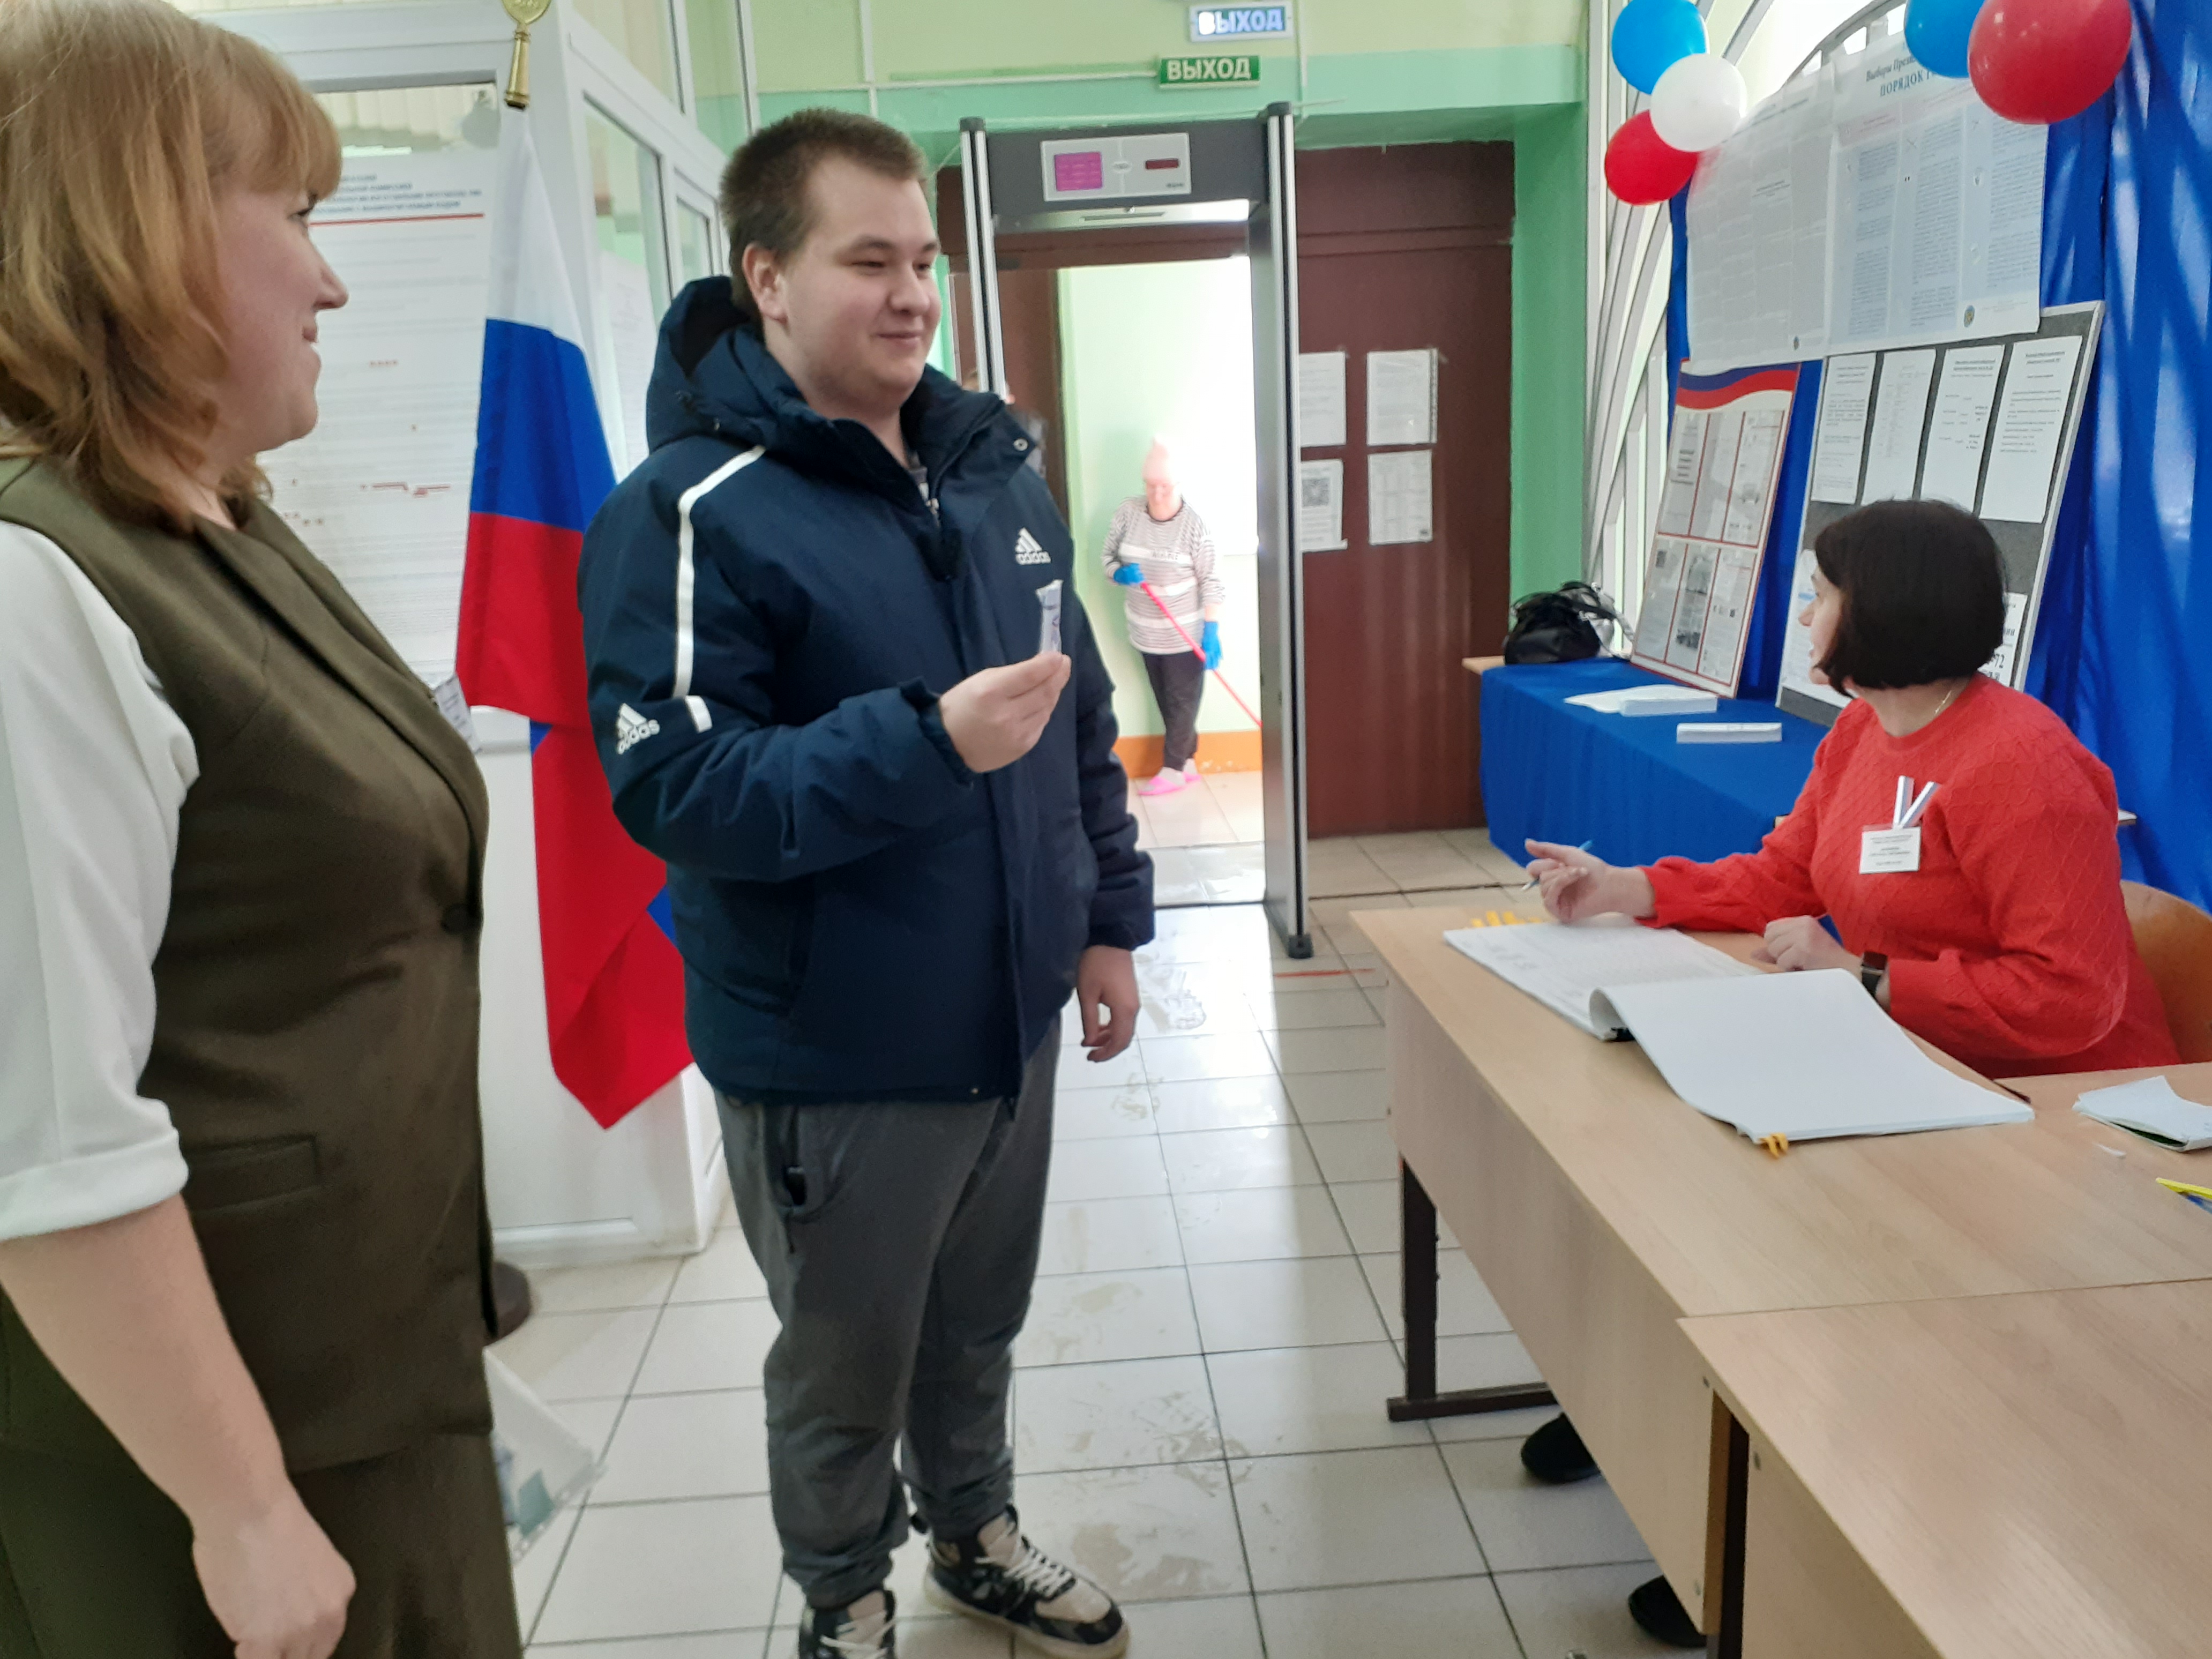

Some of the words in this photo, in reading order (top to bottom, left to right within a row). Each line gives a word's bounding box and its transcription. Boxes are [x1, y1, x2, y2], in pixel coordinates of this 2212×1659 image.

[1198, 9, 1283, 35] ВЫХОД
[1167, 57, 1251, 80] ВЫХОД
[1893, 54, 1916, 71] Прези
[1880, 70, 1924, 97] ПОРЯДОК
[1015, 551, 1051, 565] adidas
[617, 719, 660, 754] adidas
